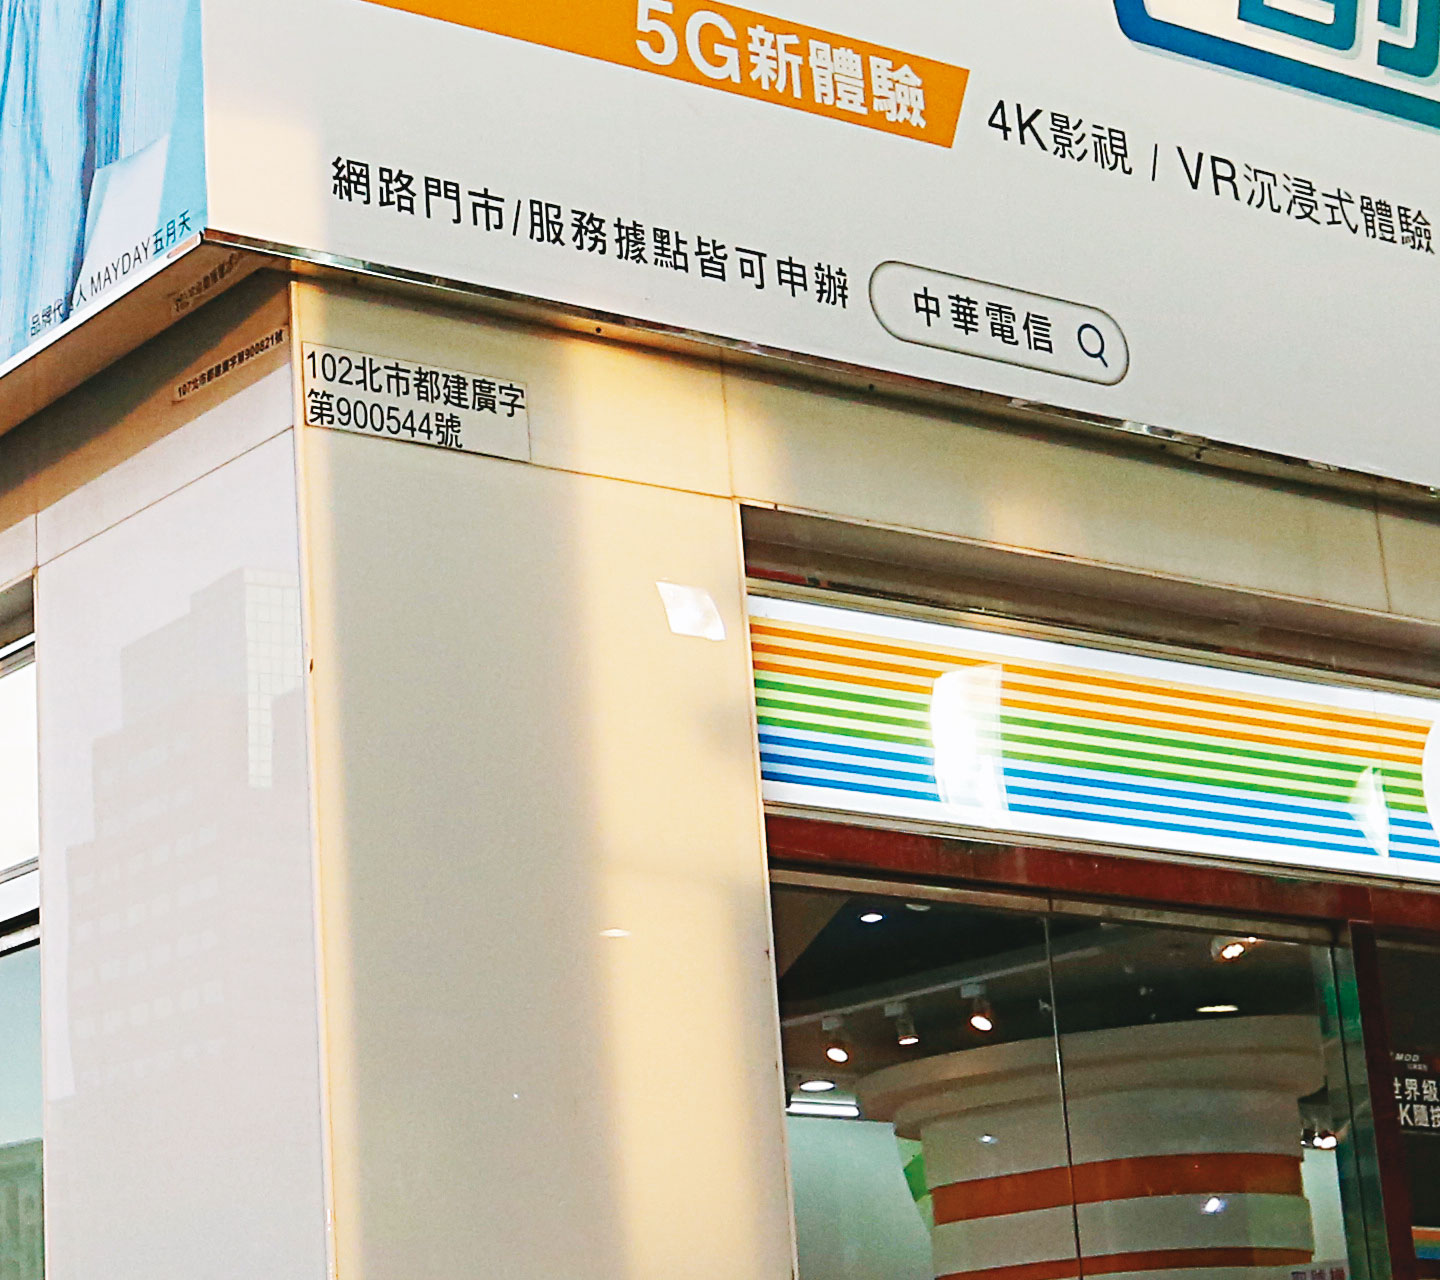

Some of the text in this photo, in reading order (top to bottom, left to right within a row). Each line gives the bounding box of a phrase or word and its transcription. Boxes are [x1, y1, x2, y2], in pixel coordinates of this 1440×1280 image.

[987, 99, 1132, 177] 4K影視
[1177, 144, 1436, 257] VR沉浸式體驗
[89, 209, 193, 297] MAYDAY五月天
[331, 156, 850, 311] 網路門市/服務據點皆可申辦
[912, 284, 1054, 356] 中華電信
[306, 350, 526, 418] 102北市都建廣字
[307, 389, 464, 449] 第900544號
